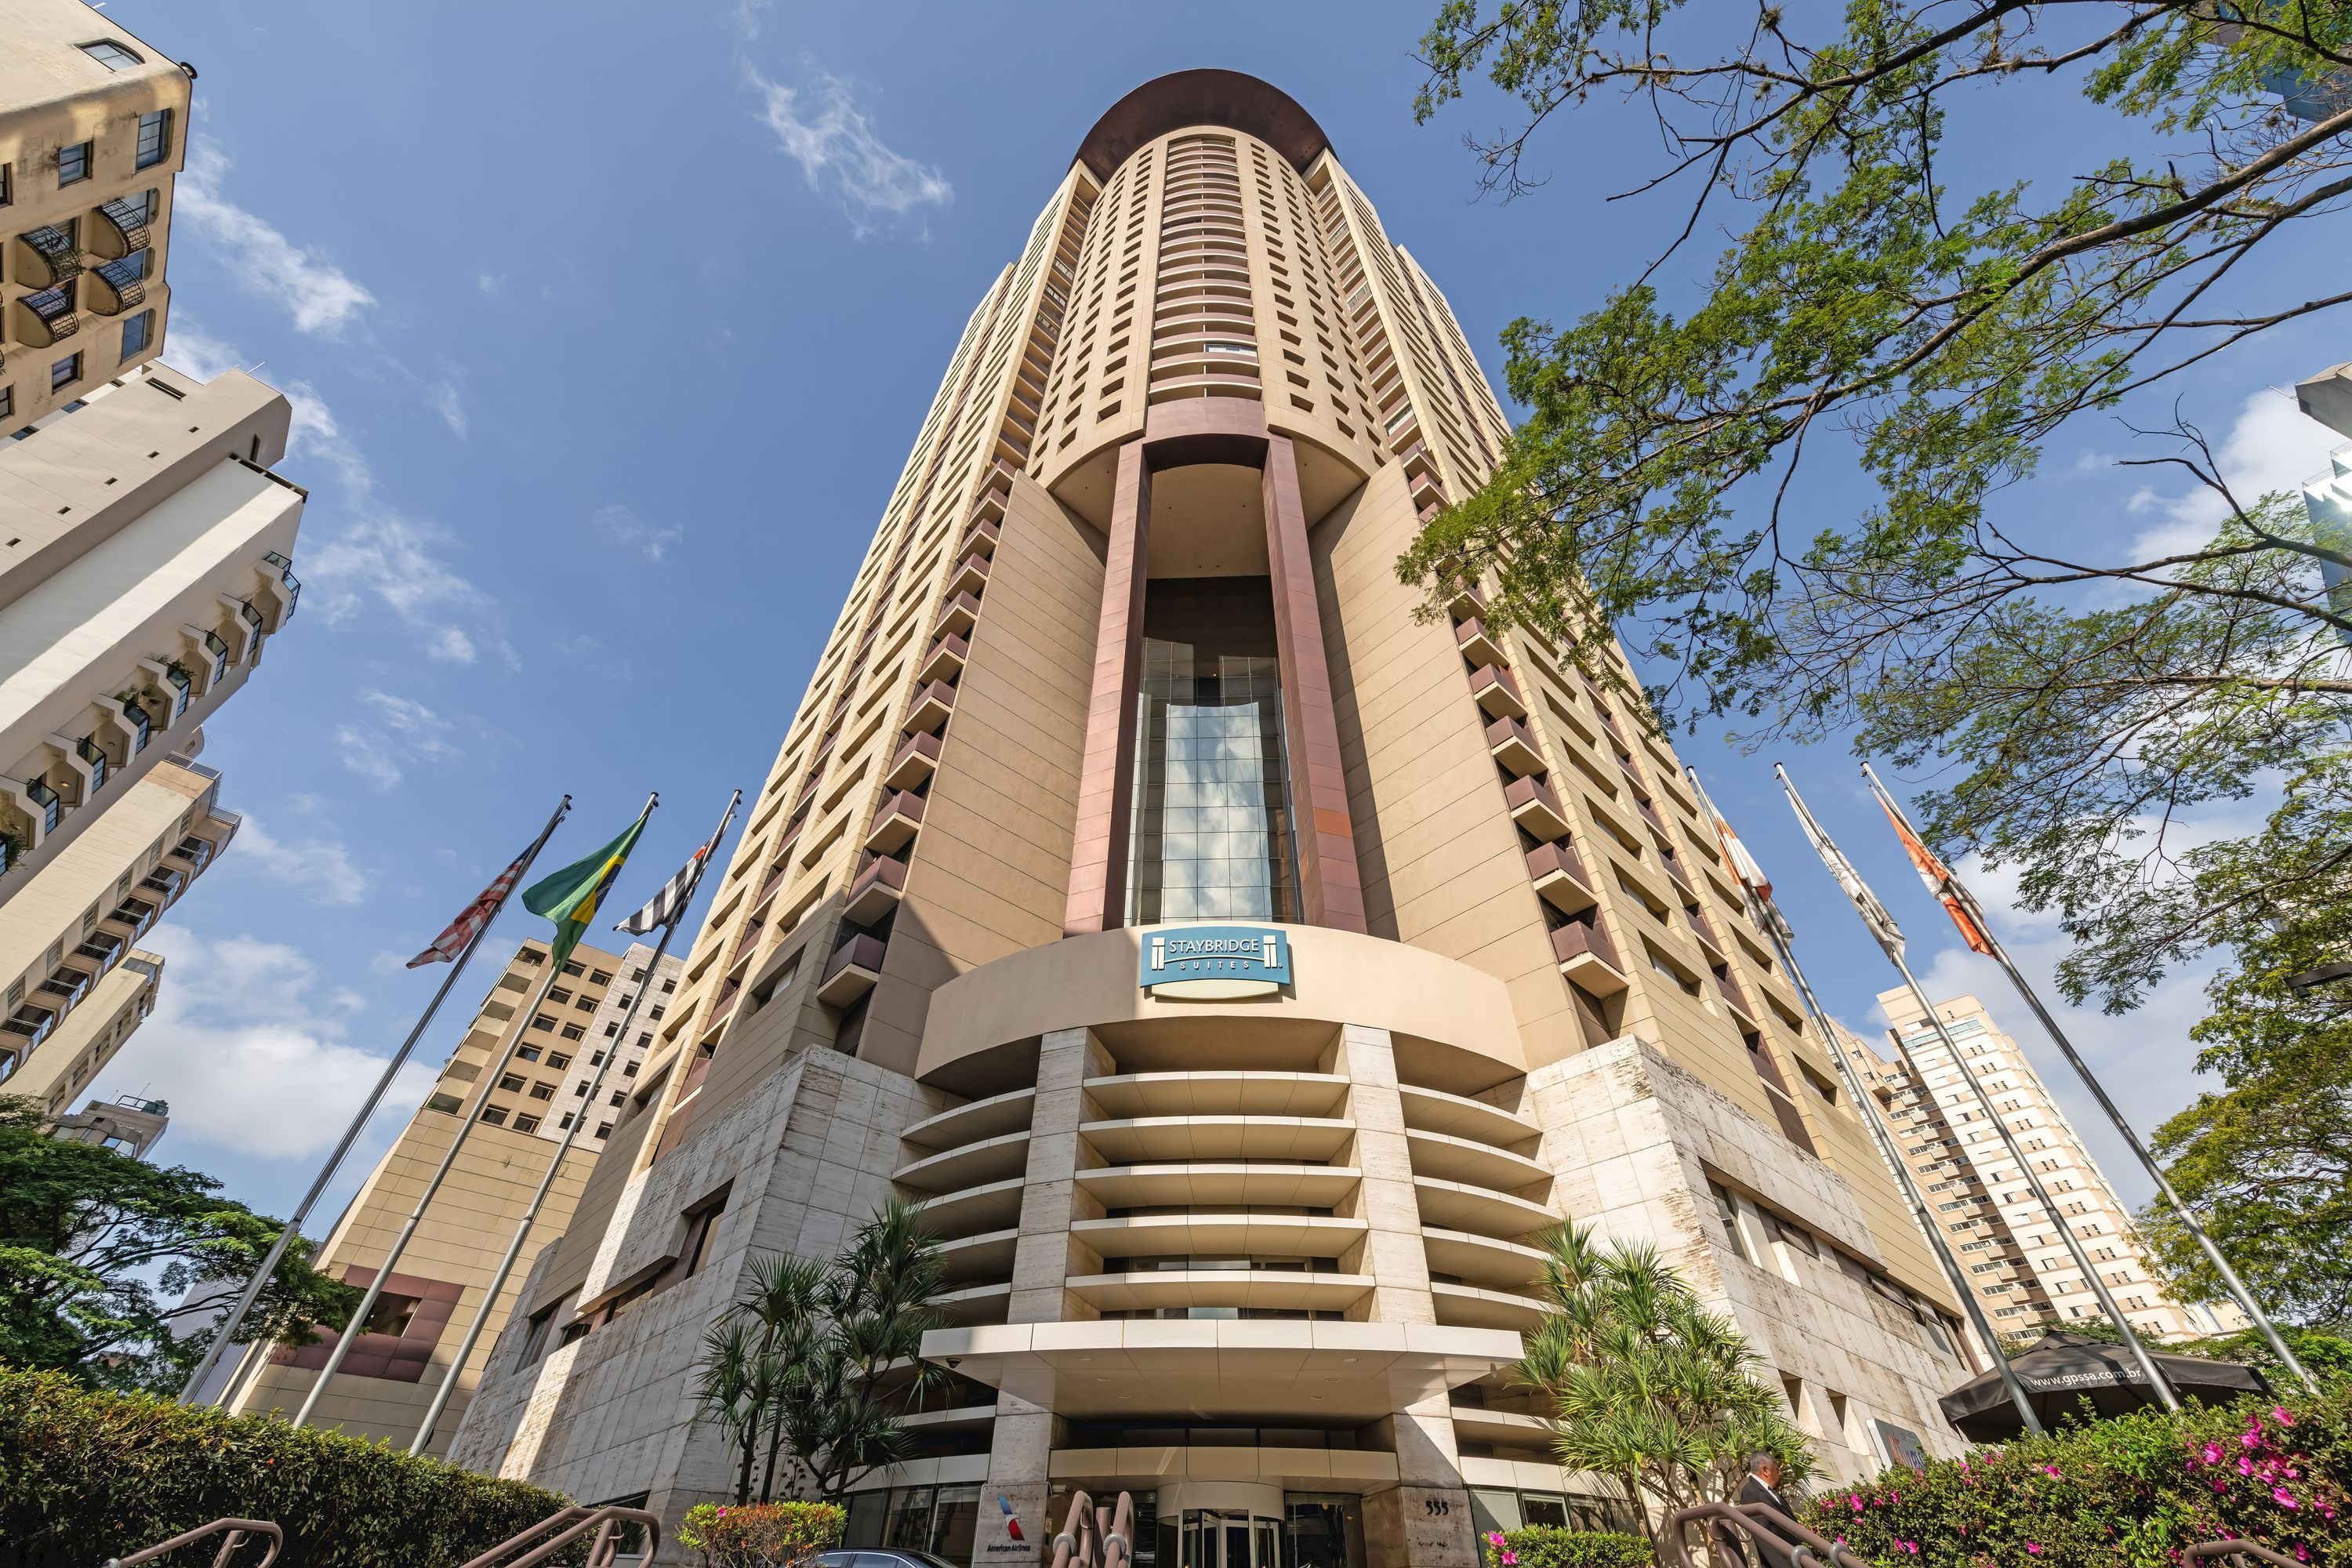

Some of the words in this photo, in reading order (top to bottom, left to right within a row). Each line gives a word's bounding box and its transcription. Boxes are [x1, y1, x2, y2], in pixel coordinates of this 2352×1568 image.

[1169, 939, 1259, 953] STAYBRIDGE
[1180, 961, 1250, 970] SUITES
[2031, 1368, 2141, 1386] www.gpssa.com.br
